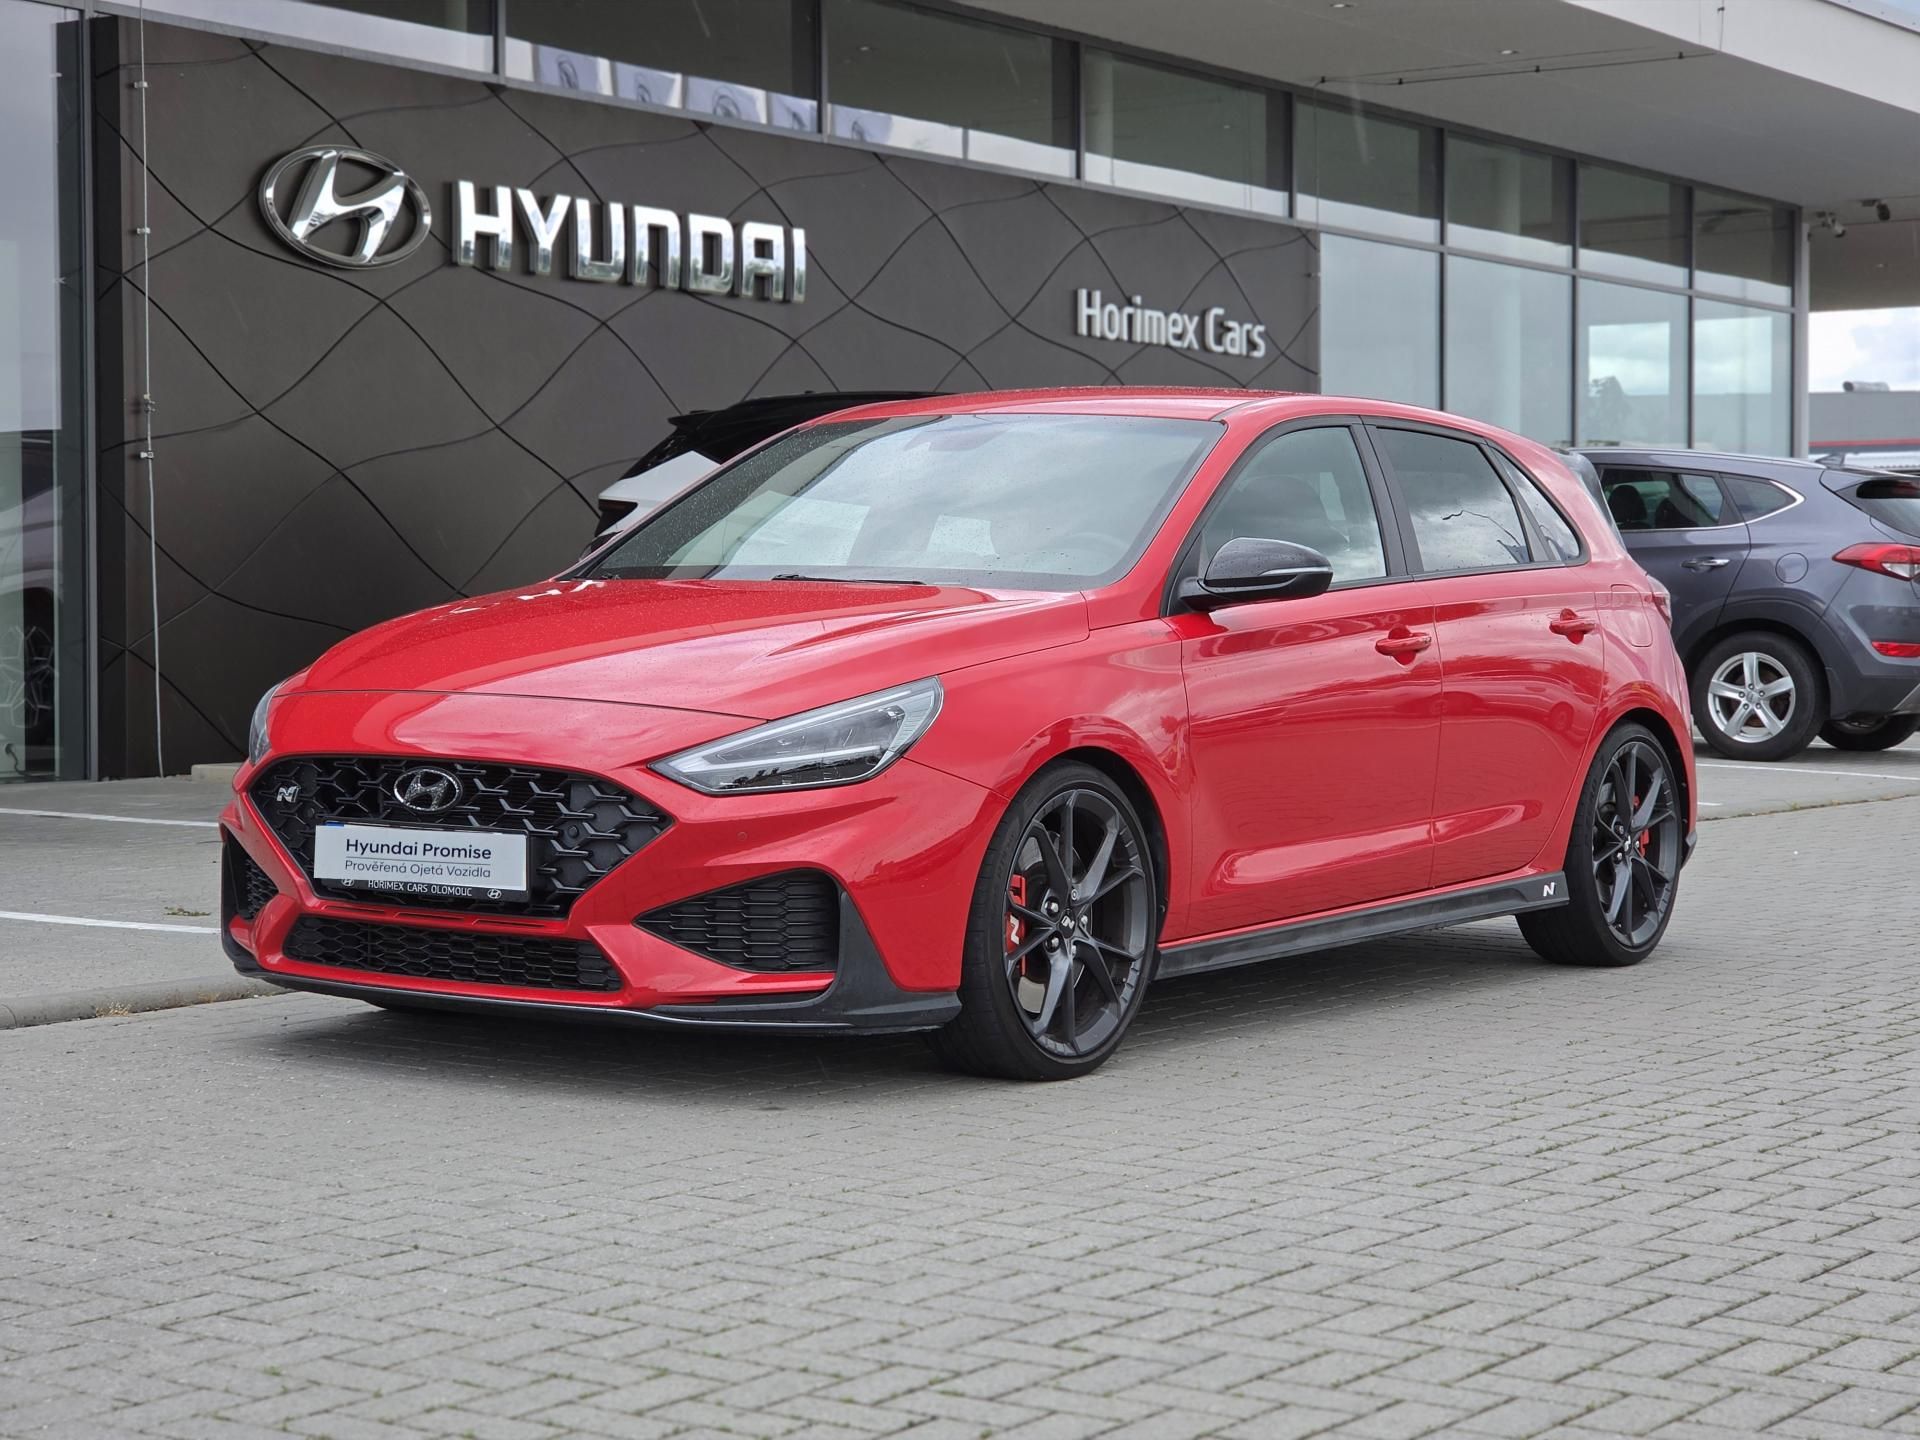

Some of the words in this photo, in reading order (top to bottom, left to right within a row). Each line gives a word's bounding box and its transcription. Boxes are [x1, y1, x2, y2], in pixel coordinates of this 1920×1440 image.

[455, 180, 806, 302] HYUNDAI
[1077, 288, 1199, 350] Horimex
[1205, 307, 1266, 358] Cars
[346, 839, 418, 855] Hyundai
[423, 843, 492, 859] Promise
[345, 860, 407, 873] Prověřená
[410, 863, 443, 877] Ojetá
[446, 865, 491, 878] Vozidla
[368, 879, 404, 891] HORIMEX
[407, 883, 428, 893] CARS
[431, 885, 473, 897] OLOMOUC
[1543, 882, 1555, 896] N
